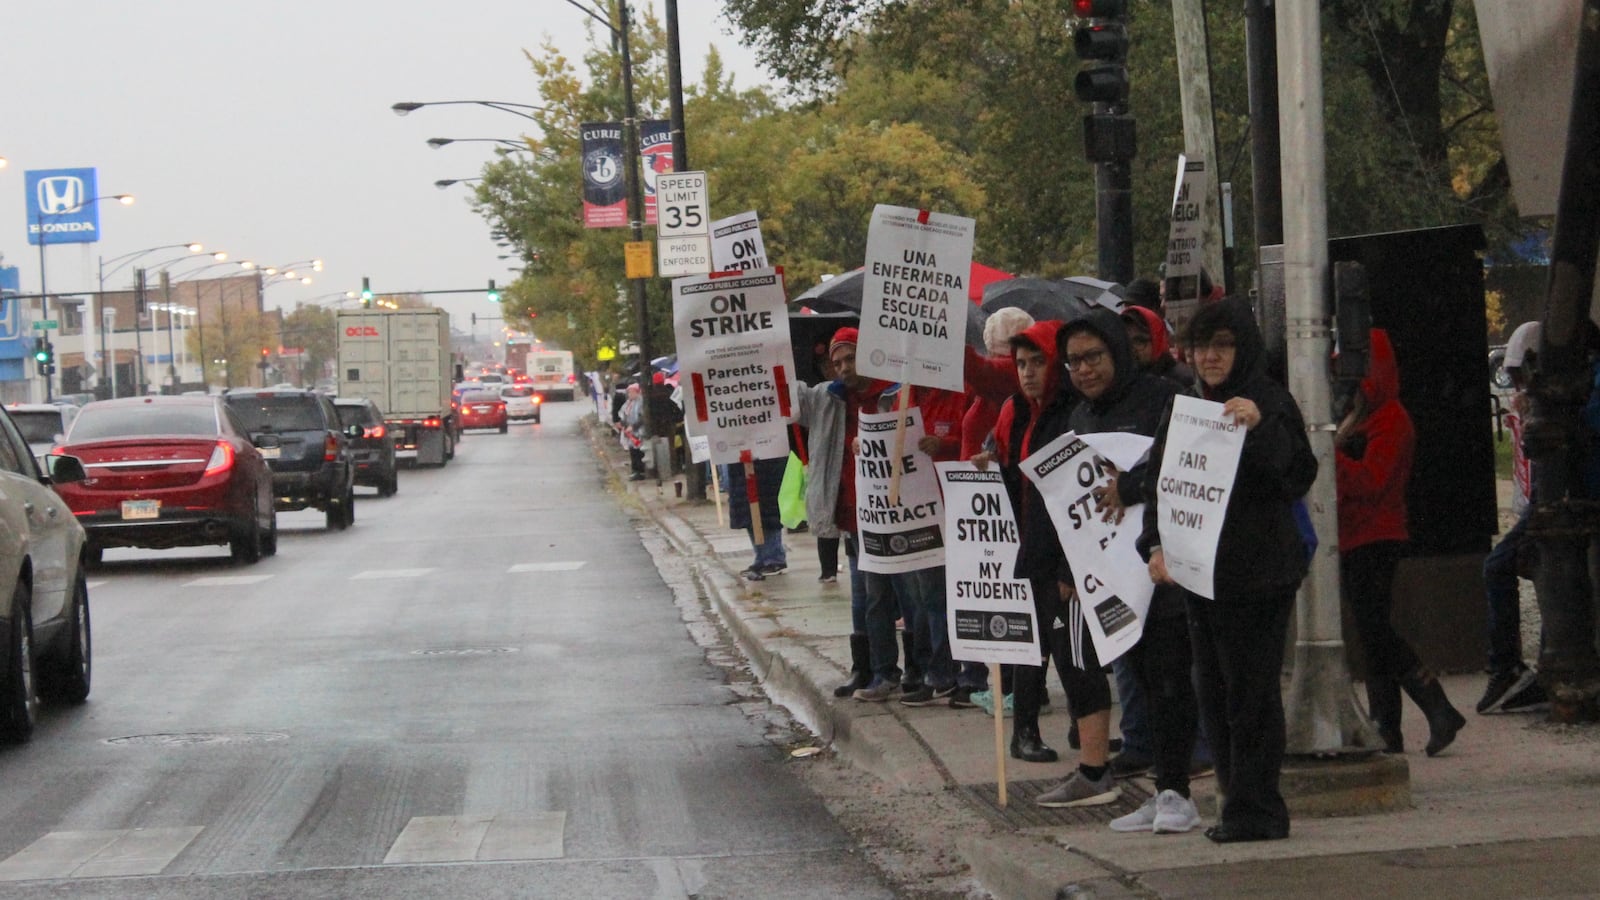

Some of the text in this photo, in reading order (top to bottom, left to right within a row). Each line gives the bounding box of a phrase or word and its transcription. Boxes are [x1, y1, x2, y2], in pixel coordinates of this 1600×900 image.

[583, 129, 621, 140] CURIE
[642, 132, 672, 146] CURI
[660, 178, 702, 190] SPEED
[665, 191, 698, 203] LIMIT
[665, 205, 702, 229] 35
[1173, 203, 1200, 221] ELGA
[29, 222, 95, 233] HONDA
[670, 244, 697, 253] PHOTO
[732, 237, 757, 260] ON
[663, 256, 706, 267] ENFORCED
[903, 249, 936, 268] UNA
[682, 276, 774, 294] CHICAGO PUBLIC SCHOOLS
[872, 262, 962, 290] ENFERMERA
[883, 281, 949, 305] EN CADA
[710, 292, 747, 314] ON
[882, 298, 947, 322] ESCUELA
[690, 311, 773, 338] STRIKE
[879, 314, 948, 340] CADA DÍA
[707, 363, 768, 380] Parents,
[704, 379, 775, 397] Teachers,
[710, 394, 775, 413] Students
[717, 411, 772, 429] United!
[878, 416, 912, 431] SCHOS
[1190, 416, 1198, 426] IN
[860, 454, 917, 479] TRIE
[1038, 448, 1073, 475] CHICAGO
[1178, 450, 1208, 472] FAIR
[947, 472, 974, 481] CHICAGO
[974, 473, 995, 482] PUBLIC
[1160, 476, 1225, 504] CONTRACT
[859, 501, 937, 525] CONTRACT
[971, 493, 1001, 516] ON
[1170, 507, 1203, 530] NOW!
[957, 518, 1017, 543] STRIKE
[984, 548, 994, 556] for
[979, 562, 1002, 579] MY
[956, 581, 1027, 601] STUDENTS
